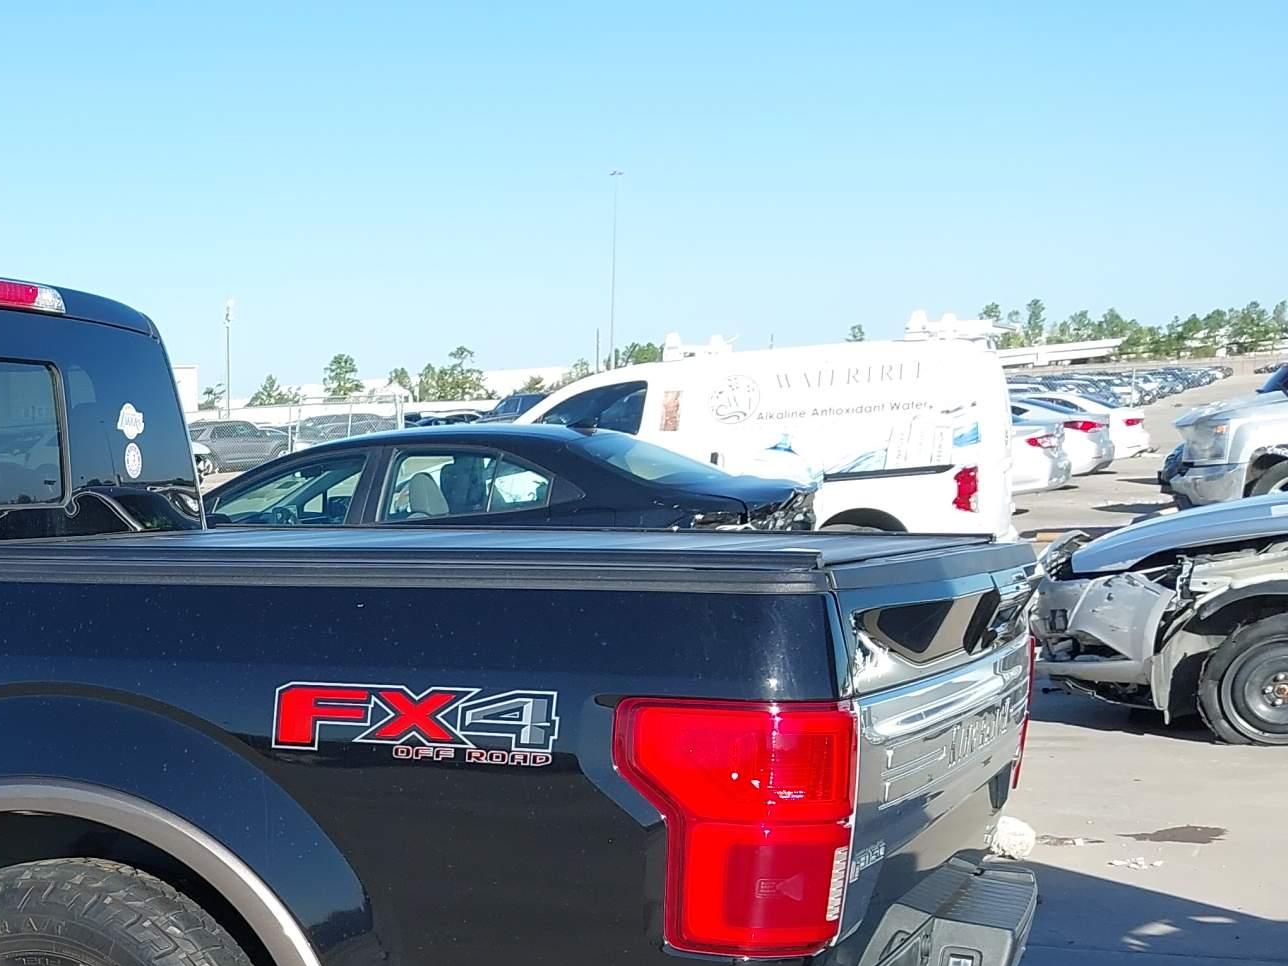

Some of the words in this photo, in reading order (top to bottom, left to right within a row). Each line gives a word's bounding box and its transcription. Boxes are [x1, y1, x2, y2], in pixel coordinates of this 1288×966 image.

[756, 410, 806, 421] Alkaline
[811, 403, 885, 417] Antioxidant
[272, 682, 559, 751] FX4
[393, 745, 455, 761] OFF
[465, 750, 552, 767] ROAD
